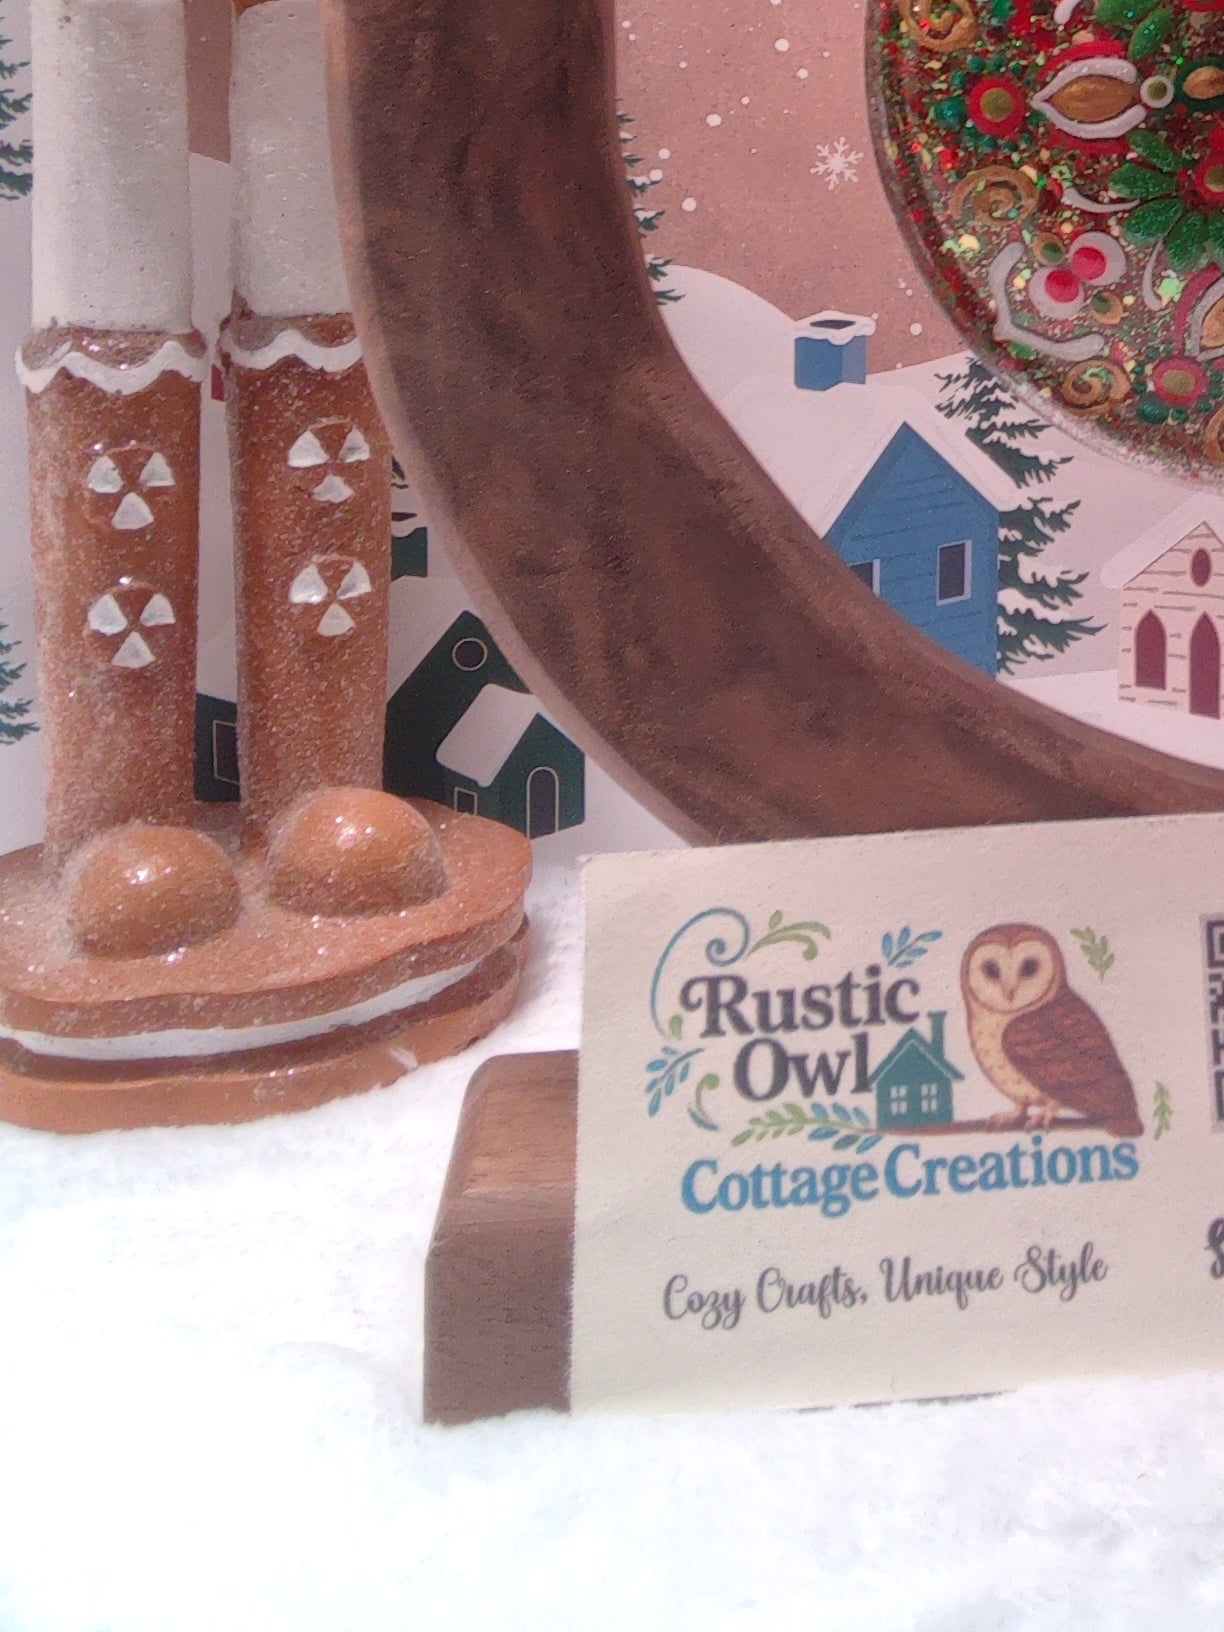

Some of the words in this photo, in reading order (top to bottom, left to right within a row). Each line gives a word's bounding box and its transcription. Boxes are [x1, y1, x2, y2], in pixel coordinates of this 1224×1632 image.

[680, 965, 921, 1039] Rustic
[733, 1032, 874, 1102] Owl
[681, 1157, 880, 1218] Cottage
[883, 1136, 1139, 1198] Creations
[663, 1272, 746, 1329] Cozy
[755, 1264, 869, 1318] Crafts,
[879, 1255, 1003, 1311] Unique
[1013, 1240, 1108, 1303] Style
